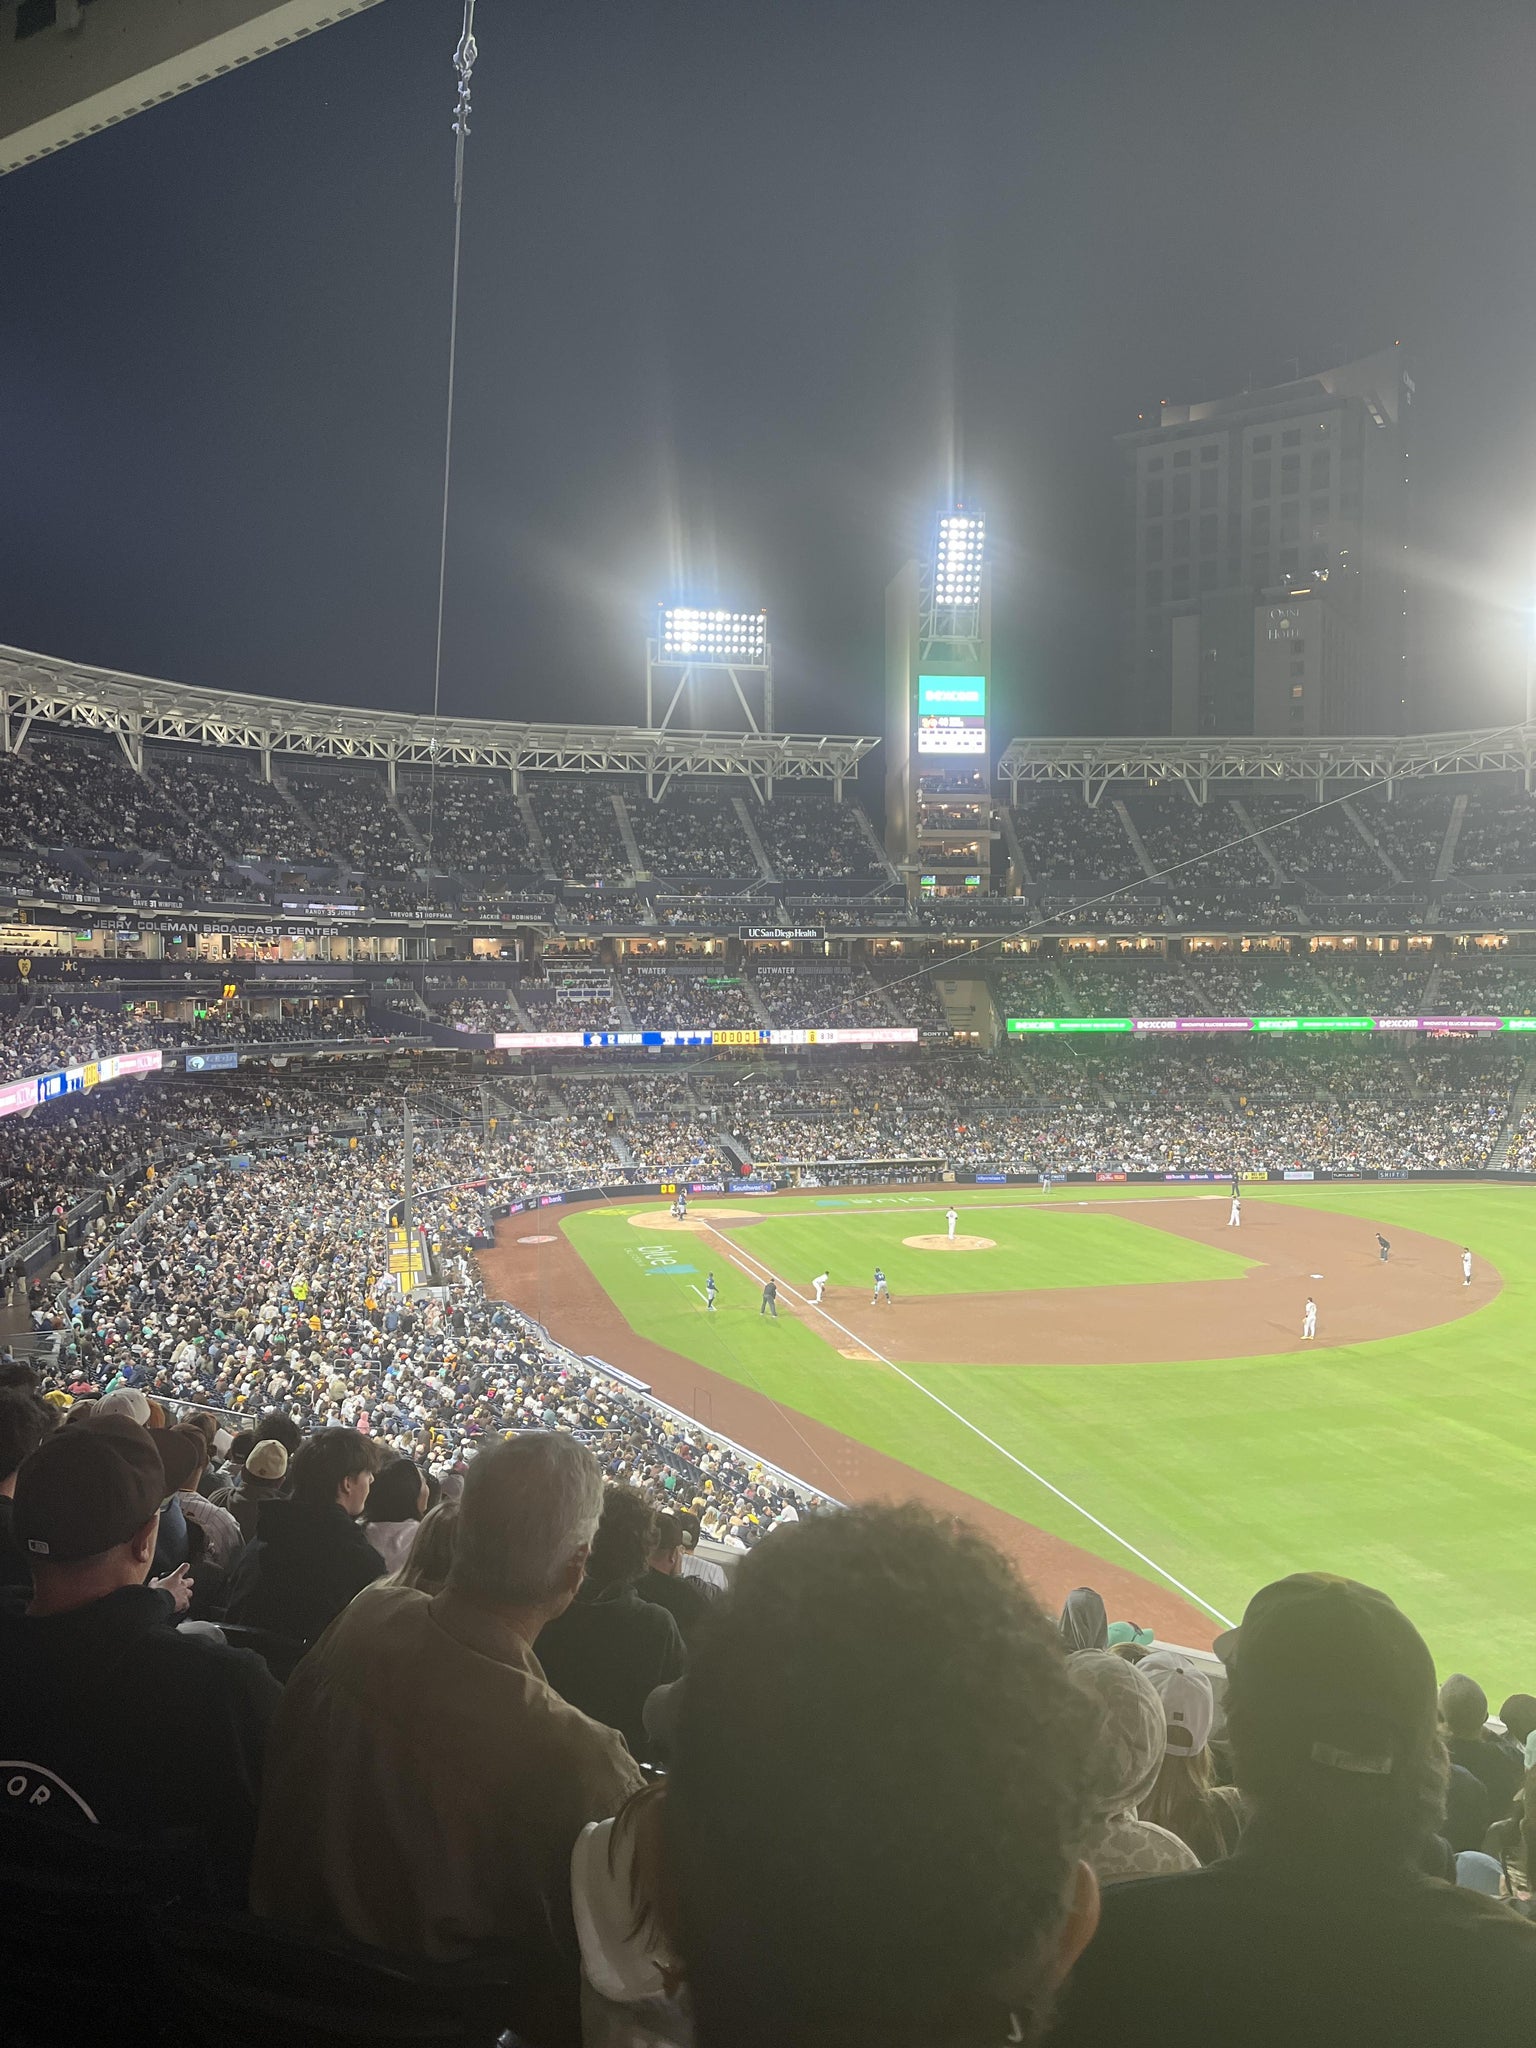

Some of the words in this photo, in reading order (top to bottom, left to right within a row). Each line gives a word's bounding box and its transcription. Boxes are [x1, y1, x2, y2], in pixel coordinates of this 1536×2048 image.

[132, 899, 148, 907] DAVE
[149, 900, 157, 908] 31
[158, 901, 183, 909] WINFIELD
[414, 911, 424, 919] 51
[93, 920, 132, 930] JERRY
[137, 921, 198, 932] COLEMAN
[203, 924, 282, 935] BROADCAST
[287, 926, 339, 936] CENTER
[748, 929, 761, 938] UC
[761, 929, 774, 938] San
[774, 929, 795, 939] Diego
[795, 929, 817, 938] Health
[627, 967, 667, 975] CTWATER
[637, 1245, 678, 1266] blue
